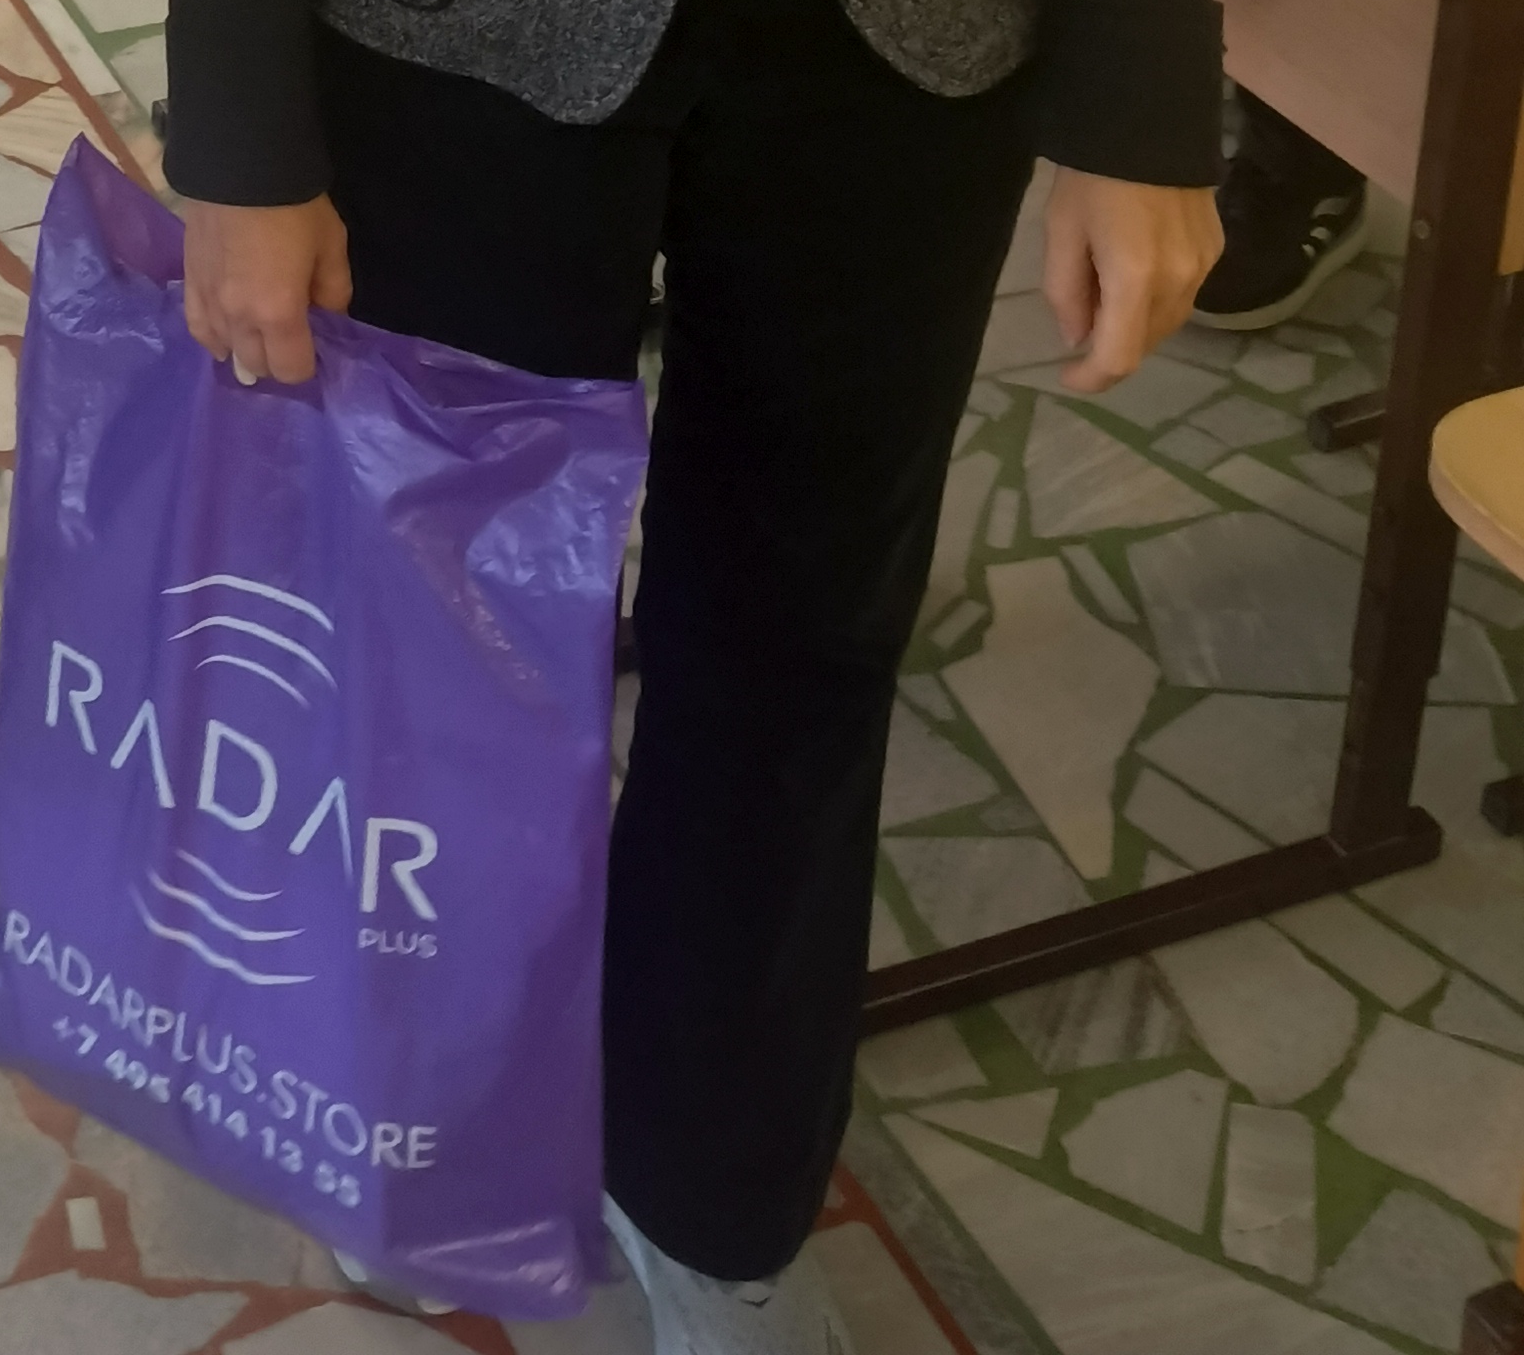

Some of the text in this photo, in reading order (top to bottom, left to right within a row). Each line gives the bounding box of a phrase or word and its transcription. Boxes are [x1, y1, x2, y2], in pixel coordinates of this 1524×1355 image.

[45, 640, 439, 922] RADAR
[3, 909, 439, 1170] RADARPLUS.STORE
[357, 927, 439, 960] PLUS
[52, 1014, 99, 1056] +7
[181, 1081, 249, 1140] 414
